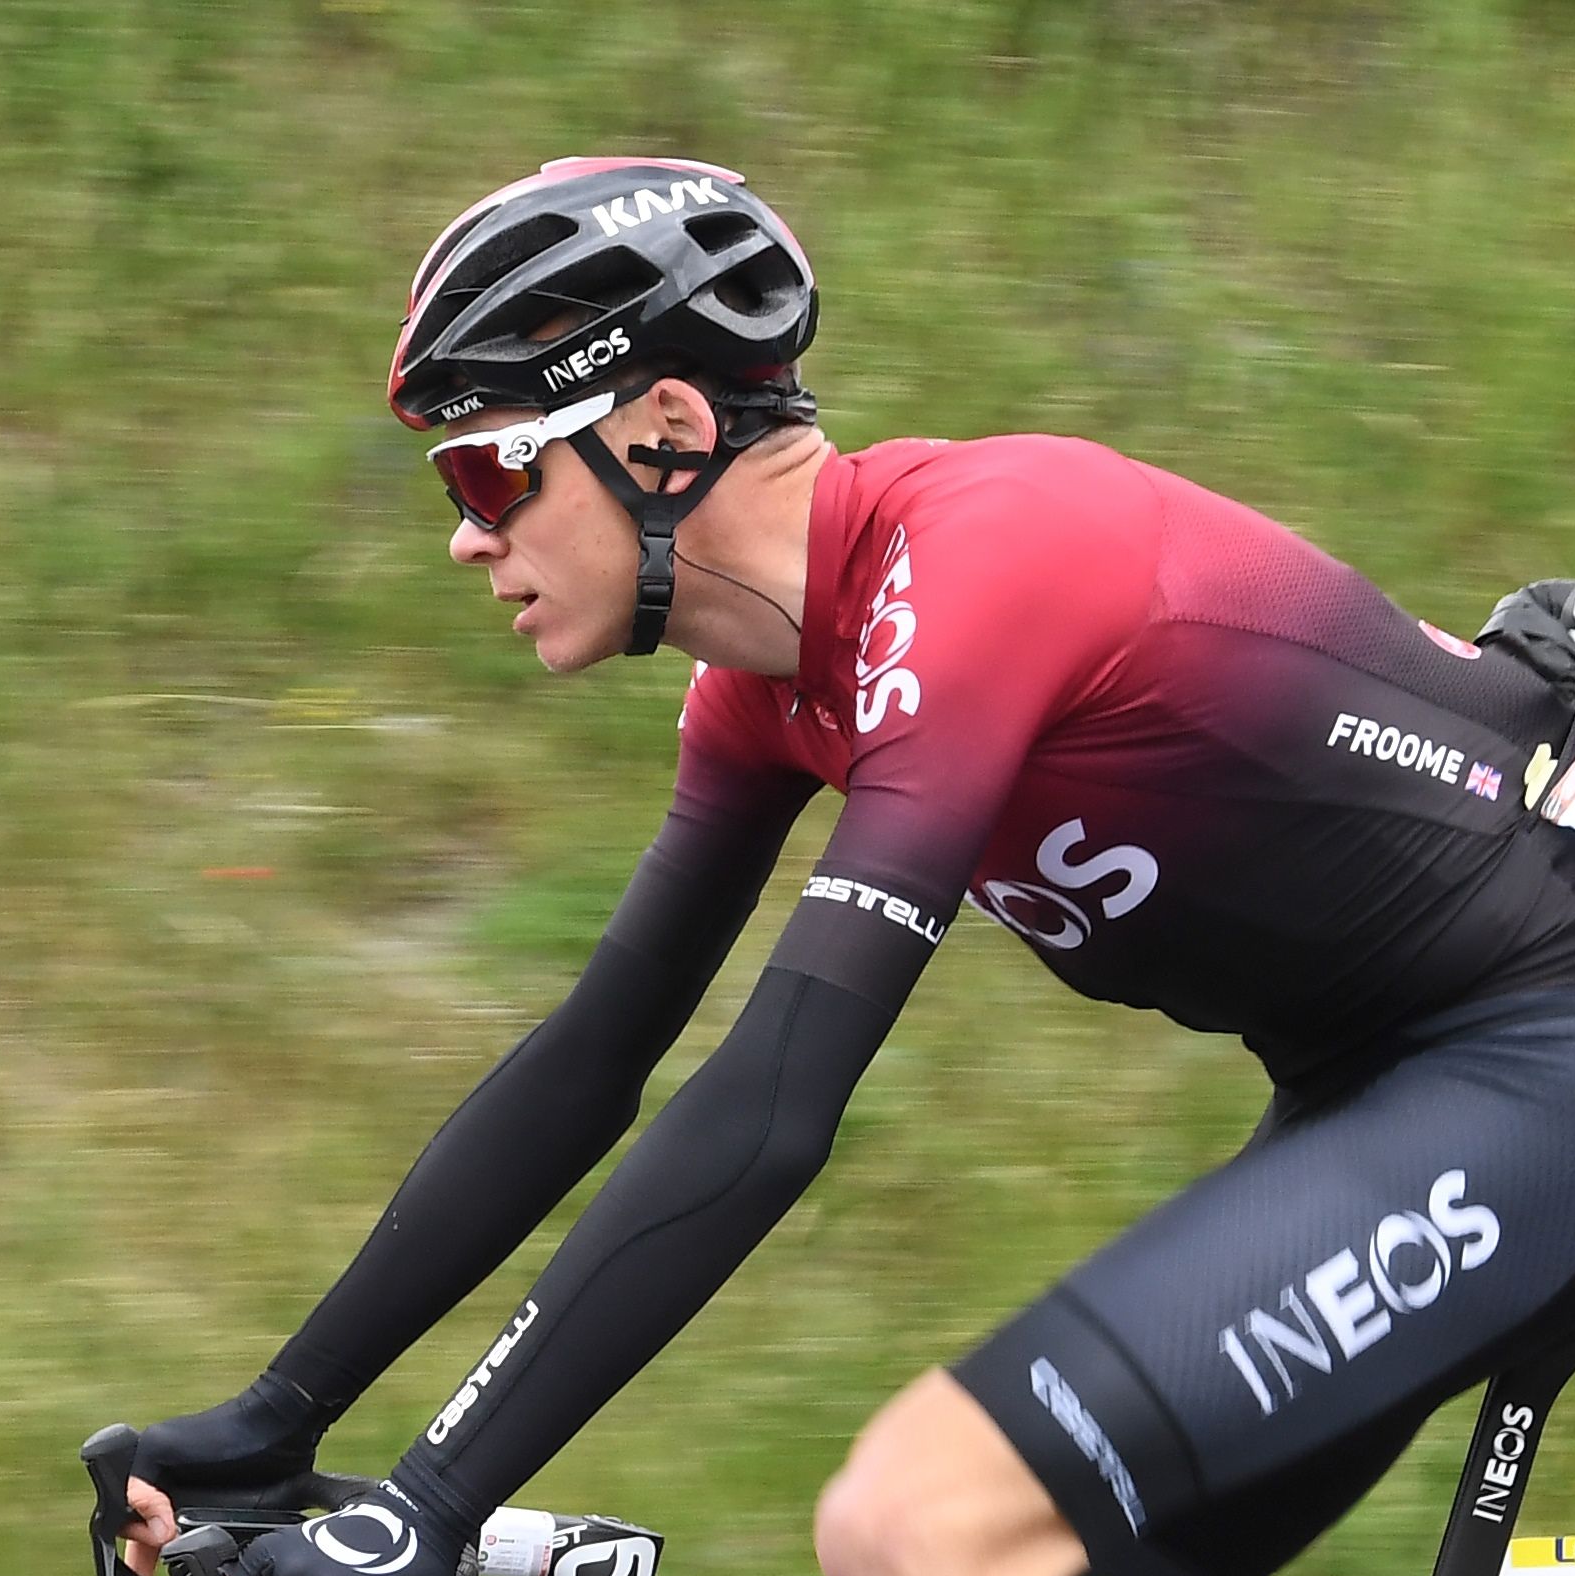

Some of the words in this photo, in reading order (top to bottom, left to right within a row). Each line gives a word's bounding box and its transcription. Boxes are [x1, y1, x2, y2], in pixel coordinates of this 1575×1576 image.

[591, 177, 729, 237] KASK
[542, 327, 631, 393] INEOS
[441, 395, 485, 421] KASK
[1326, 712, 1466, 785] FROOME
[1218, 1168, 1501, 1418] INEOS
[1471, 1402, 1534, 1524] INEOS
